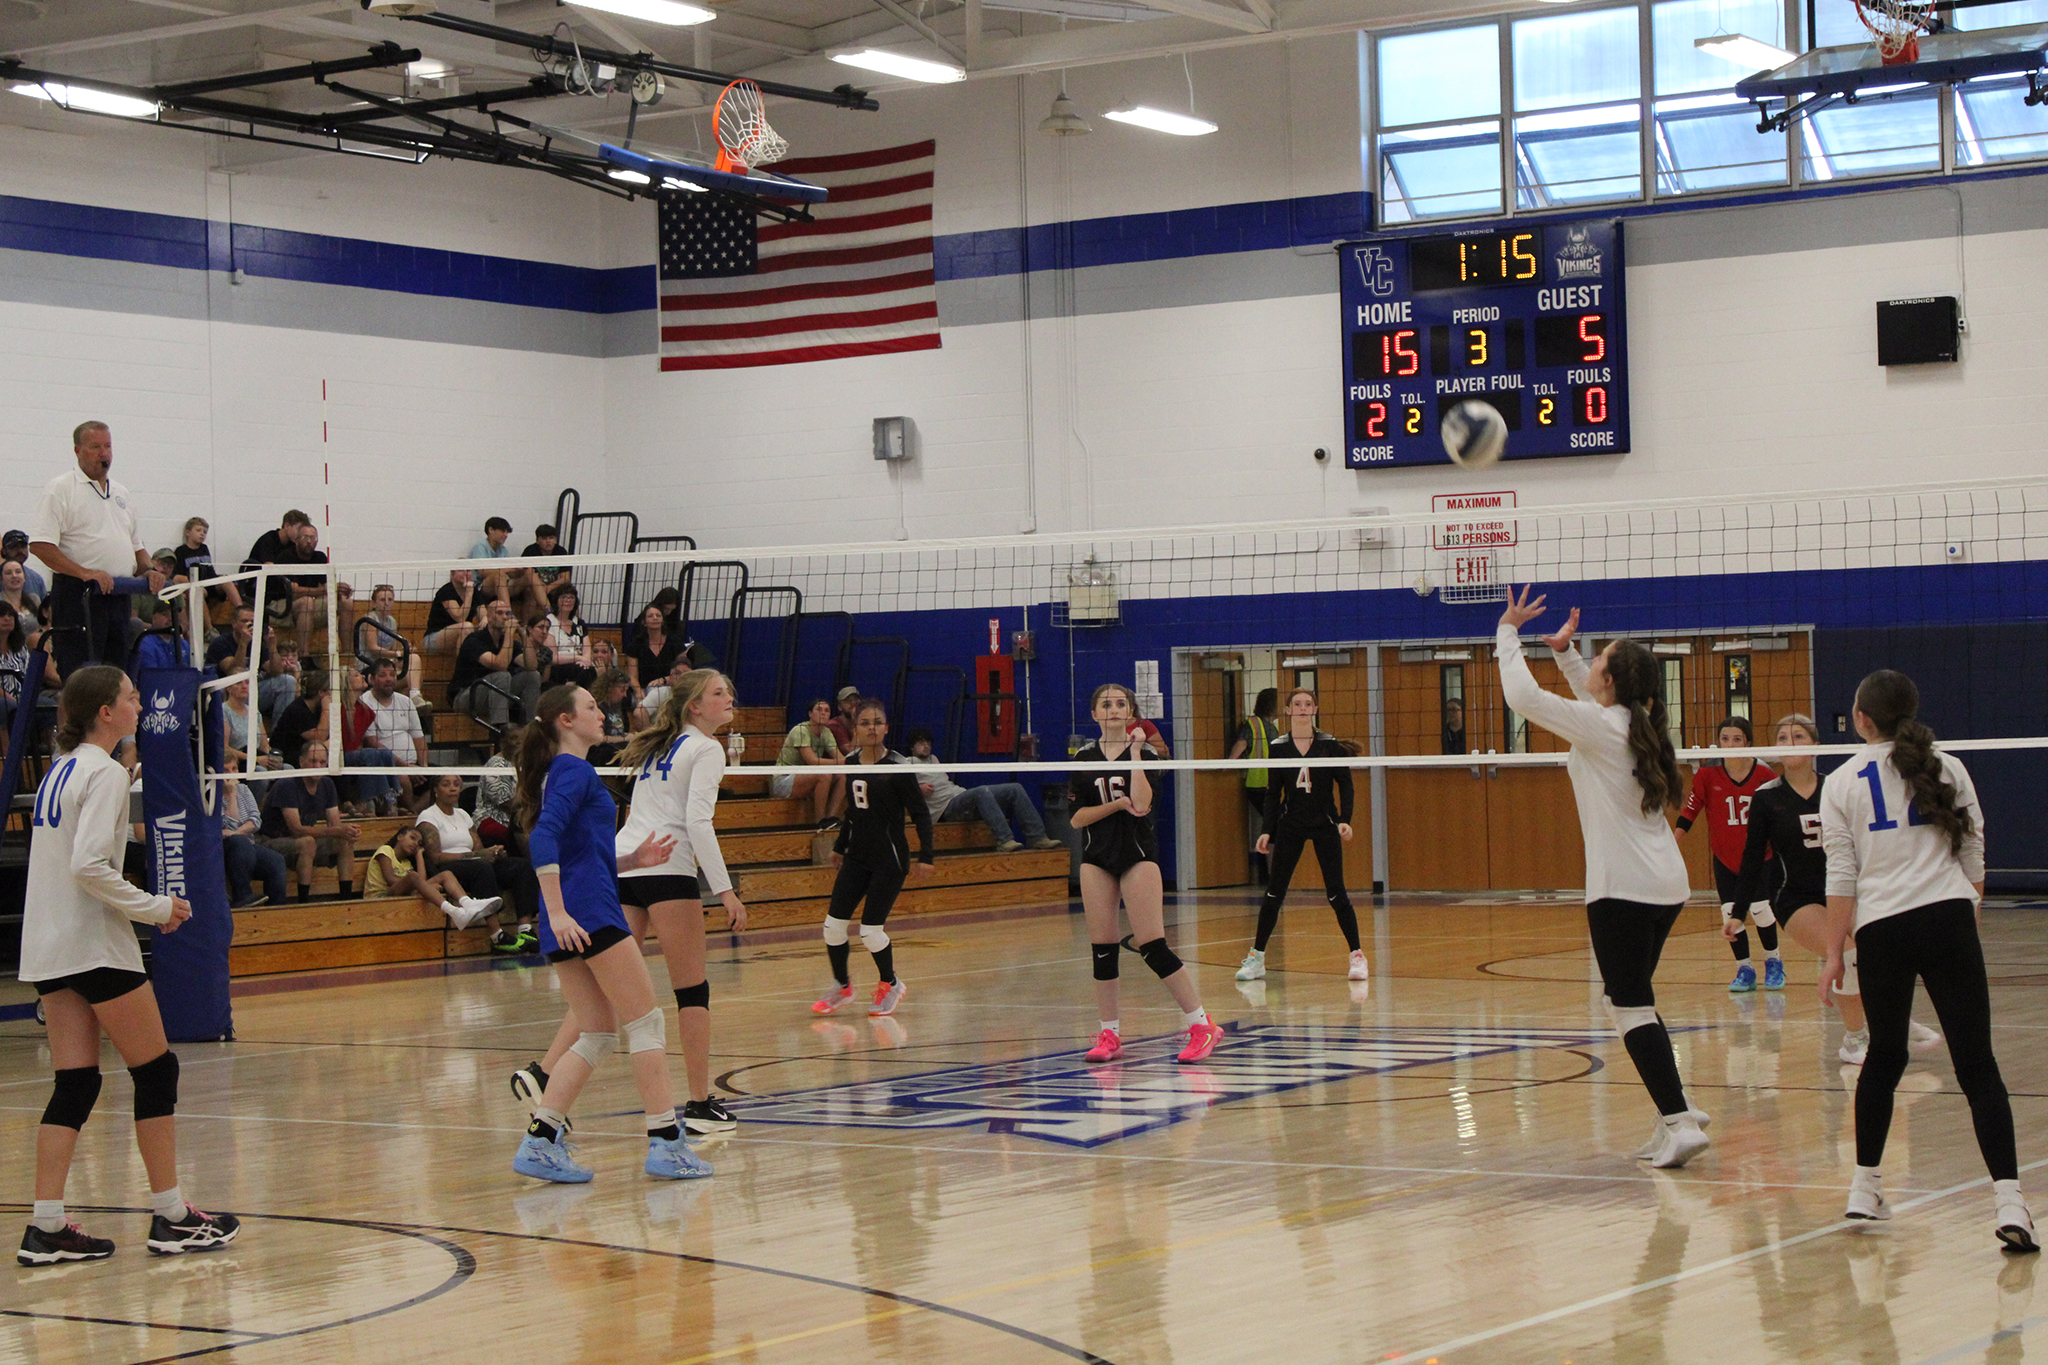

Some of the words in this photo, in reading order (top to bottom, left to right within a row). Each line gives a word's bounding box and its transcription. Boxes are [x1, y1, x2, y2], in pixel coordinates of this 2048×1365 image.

[1454, 228, 1495, 237] DAKTRONICS
[1556, 254, 1602, 277] VIKINGS
[1537, 285, 1603, 311] GUEST
[1890, 298, 1936, 306] DAKTRONICS
[1357, 301, 1412, 326] HOME
[1453, 306, 1500, 324] PERIOD
[1470, 330, 1488, 365] 3
[1578, 315, 1605, 361] 5
[1382, 330, 1418, 375] 15
[1436, 376, 1486, 394] PLAYER
[1491, 374, 1525, 391] FOUL
[1567, 367, 1611, 385] FOULS
[1350, 383, 1391, 401] FOULS
[1401, 393, 1426, 405] T.O.L.
[1533, 383, 1559, 396] T.O.L.
[1539, 398, 1554, 425] 2
[1586, 386, 1607, 423] 0
[1367, 402, 1386, 438] 2
[1406, 407, 1421, 434] 2
[1570, 431, 1614, 448] SCORE
[1352, 445, 1394, 462] SCORE
[1447, 497, 1501, 510] MAXIMUM
[1446, 524, 1460, 532] NOT
[1464, 523, 1473, 531] TO
[1476, 522, 1504, 530] EXCEED
[1462, 531, 1511, 544] PERSONS
[1456, 556, 1489, 583] EXIT
[33, 757, 77, 828] 10
[1094, 776, 1125, 805] 16
[1295, 767, 1313, 794] 4
[852, 779, 869, 809] 8
[1799, 813, 1823, 849] 5
[155, 809, 190, 913] VIKING
